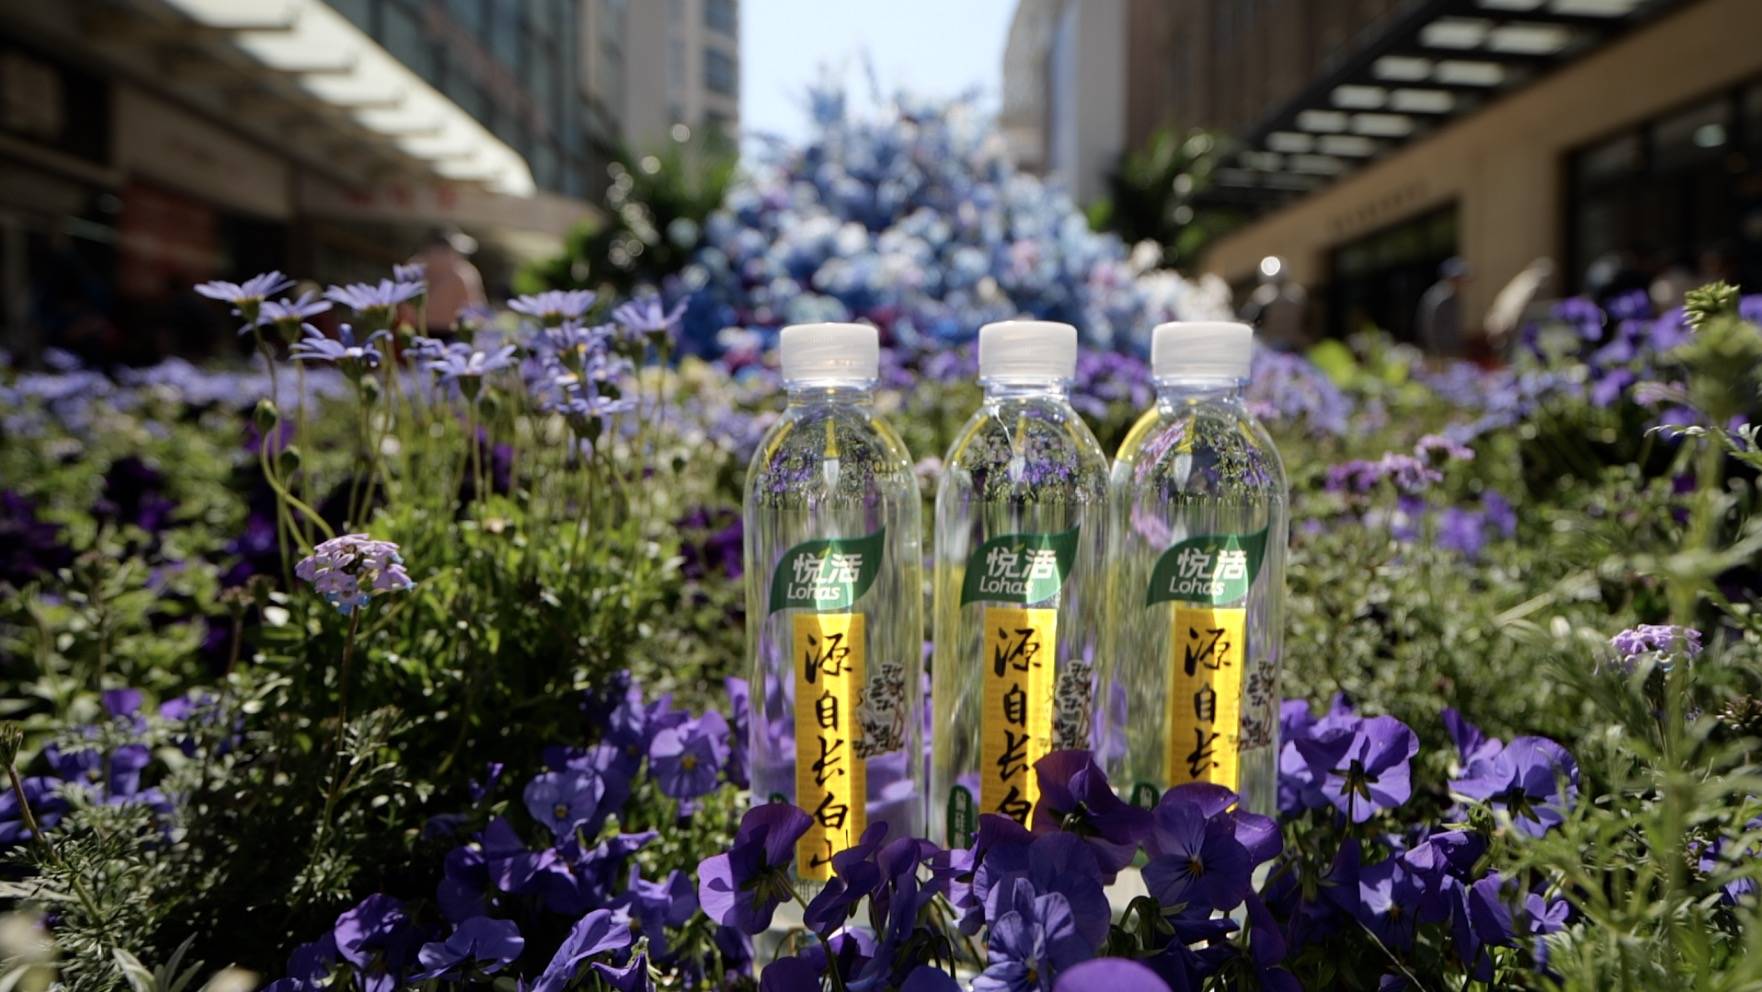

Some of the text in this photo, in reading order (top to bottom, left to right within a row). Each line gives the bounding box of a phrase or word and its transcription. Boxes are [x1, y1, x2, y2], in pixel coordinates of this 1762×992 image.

[793, 553, 862, 584] 悦活
[986, 547, 1057, 579] 悦活
[1177, 547, 1246, 580] 悦活
[787, 582, 841, 601] Lohas
[978, 575, 1034, 595] Lohas
[1168, 576, 1226, 596] Lohas
[1184, 627, 1232, 778] 源自长
